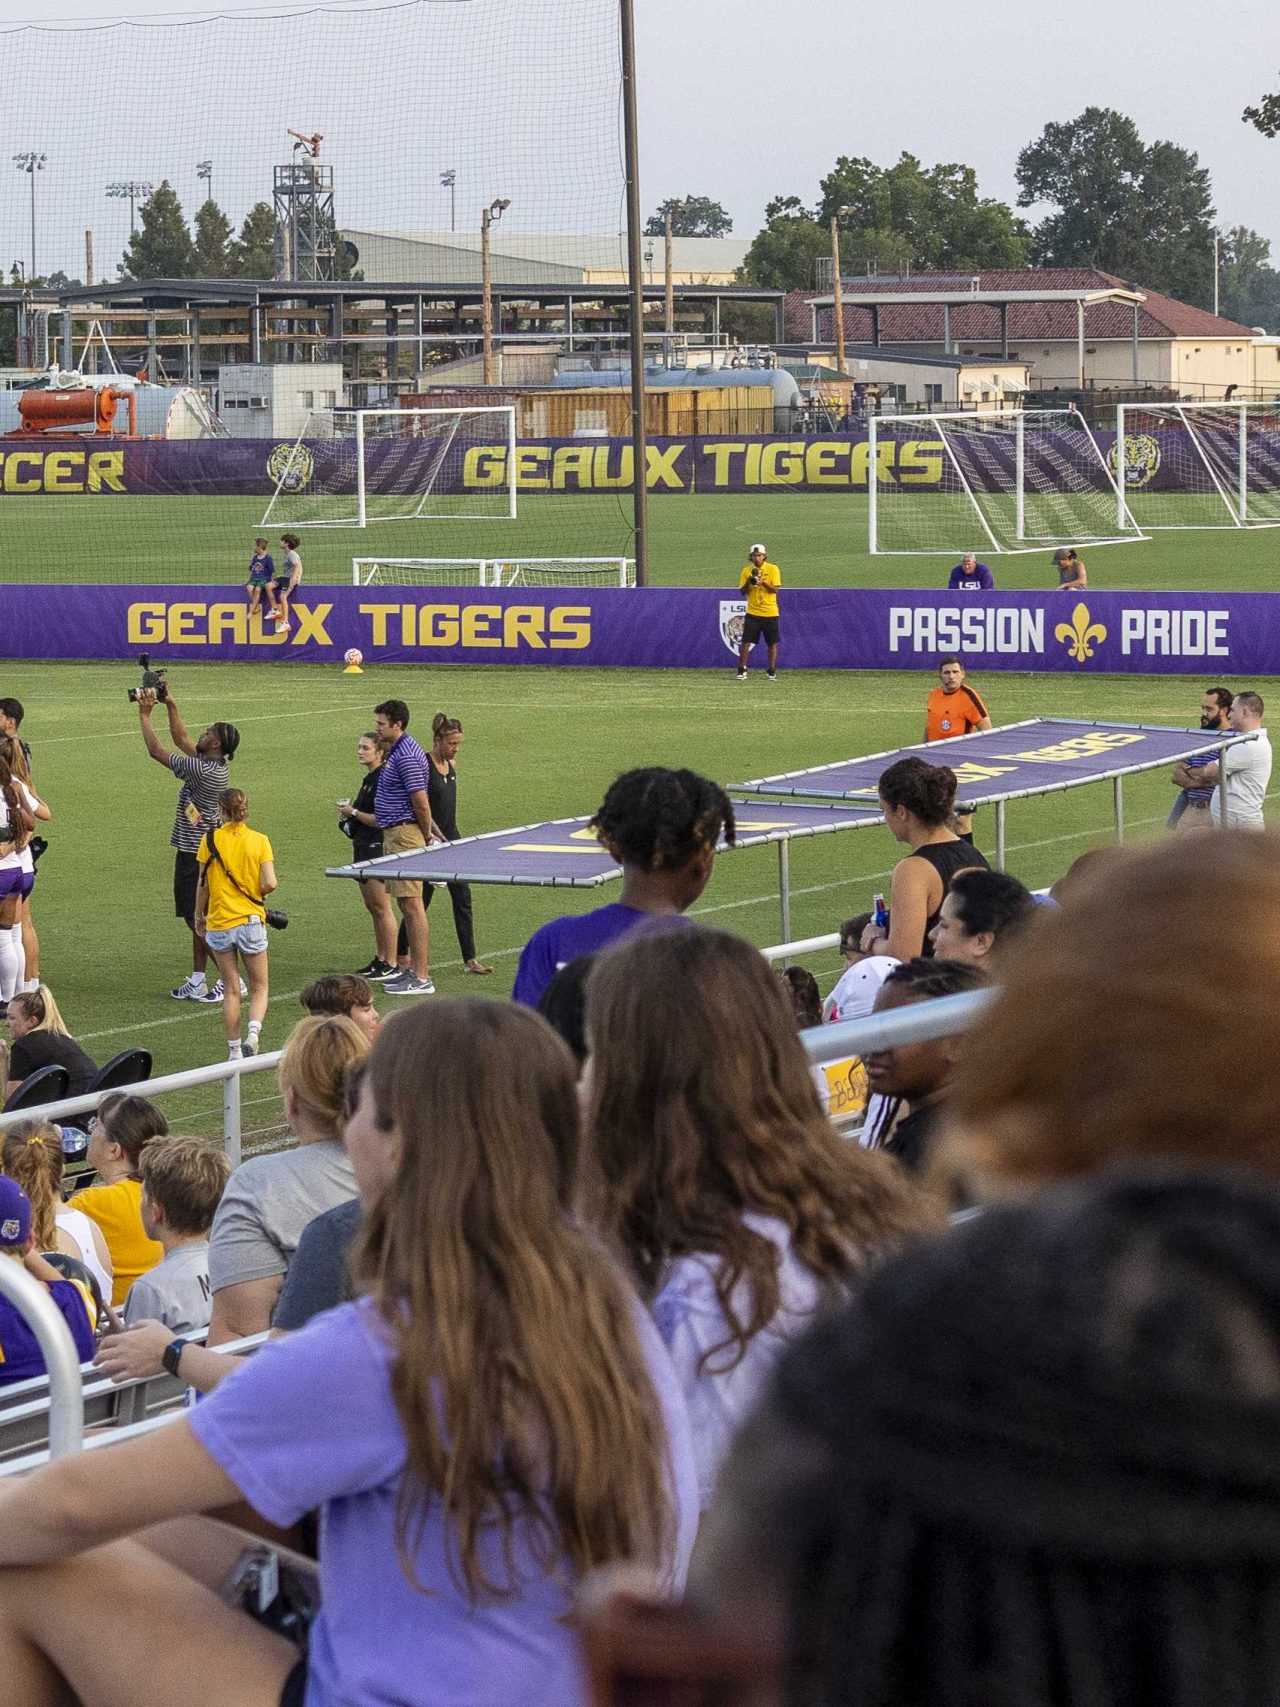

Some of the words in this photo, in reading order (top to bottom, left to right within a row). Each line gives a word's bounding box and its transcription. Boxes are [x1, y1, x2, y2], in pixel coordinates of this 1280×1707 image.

[464, 445, 687, 488] GEAUX
[703, 441, 944, 486] TIGERS
[127, 603, 334, 645] GEAUX
[359, 604, 592, 649] TIGERS
[889, 607, 1045, 653] PASSION
[1121, 609, 1230, 656] PRIDE
